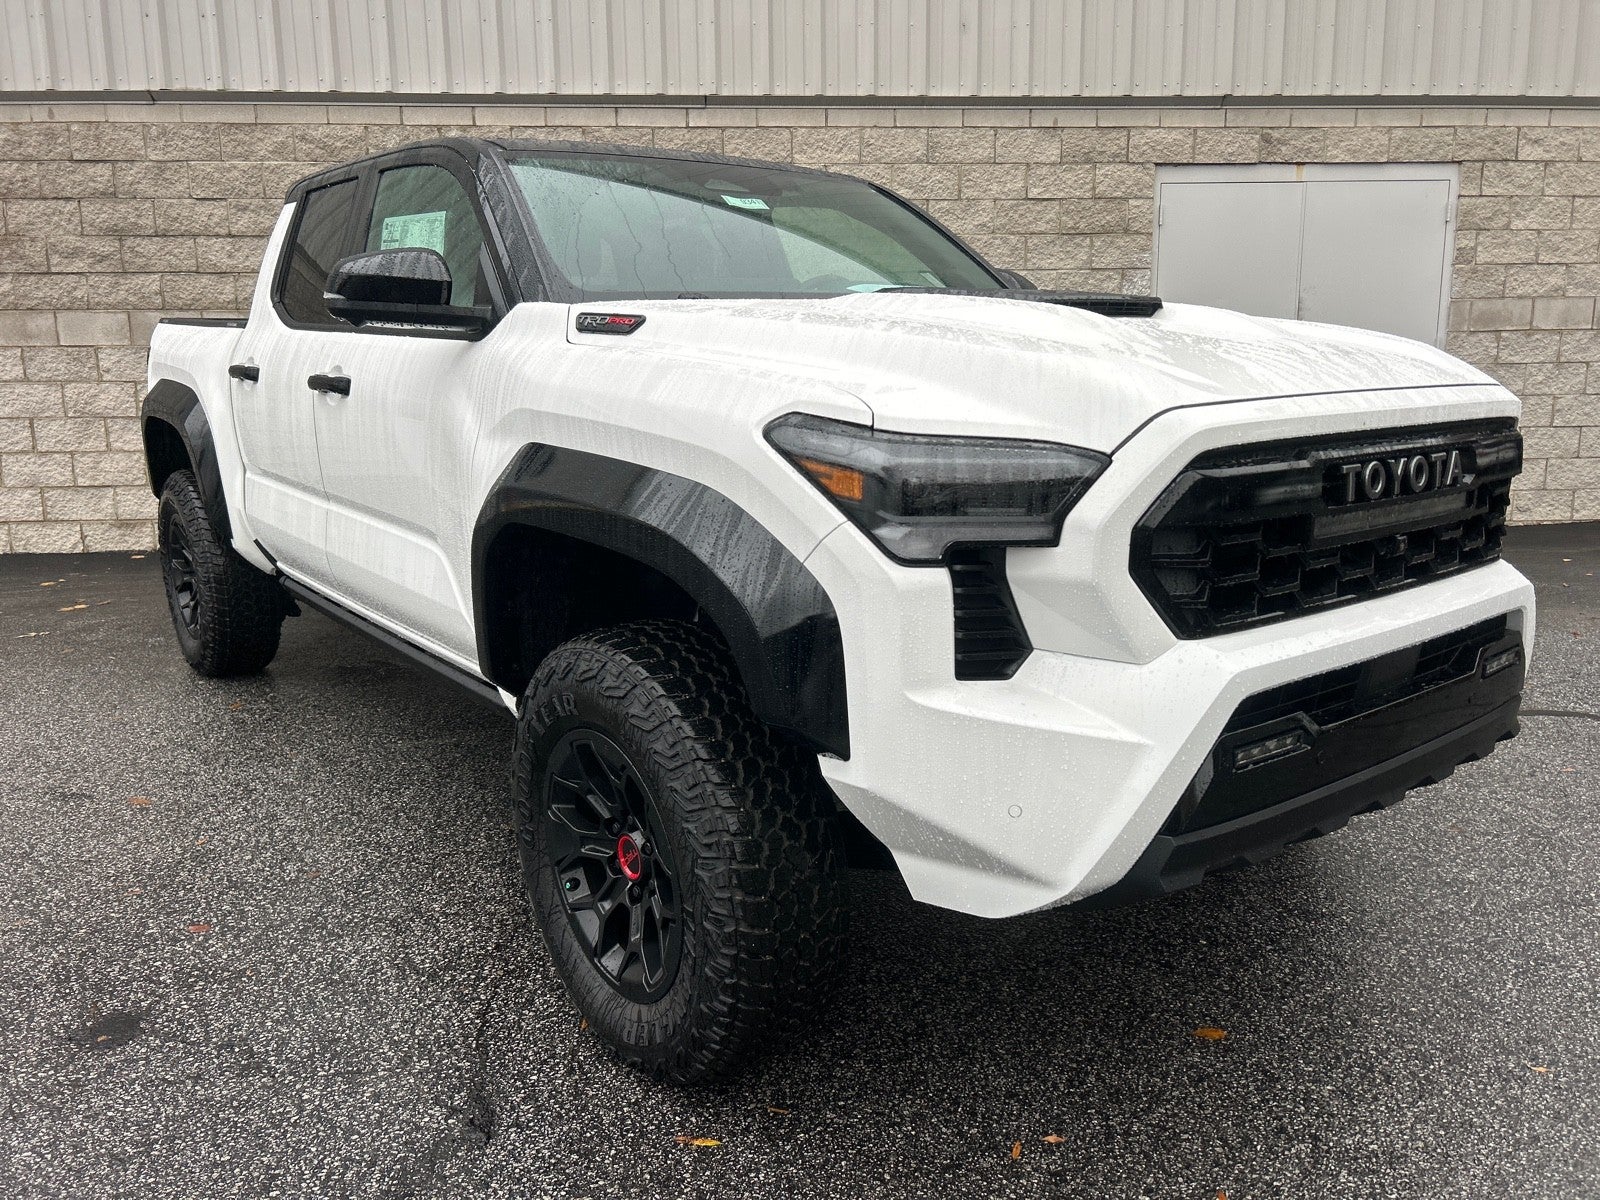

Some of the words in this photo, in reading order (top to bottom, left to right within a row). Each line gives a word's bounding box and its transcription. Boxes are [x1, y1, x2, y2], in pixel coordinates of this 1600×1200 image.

[579, 315, 609, 327] TRD
[608, 317, 635, 326] PRO
[1341, 450, 1463, 502] TOYOTA
